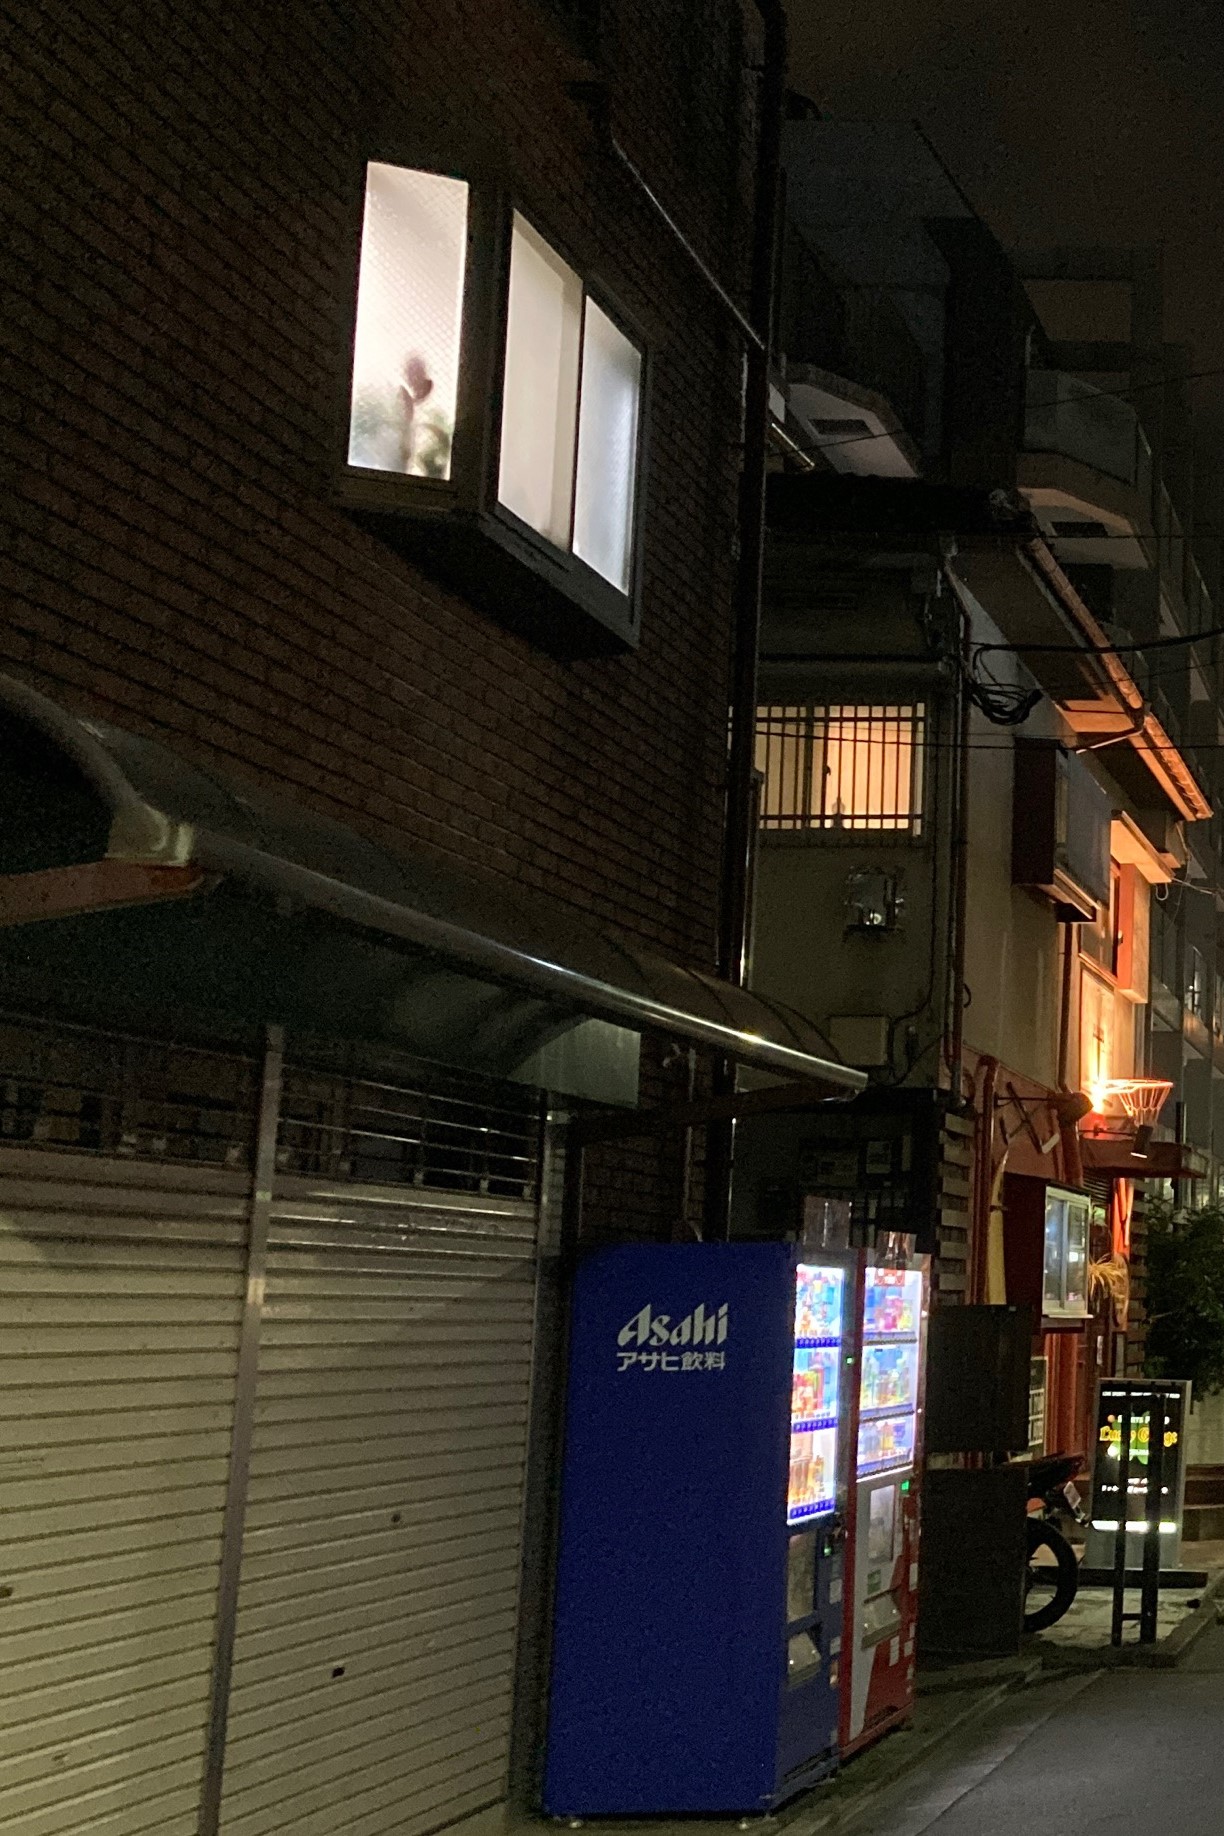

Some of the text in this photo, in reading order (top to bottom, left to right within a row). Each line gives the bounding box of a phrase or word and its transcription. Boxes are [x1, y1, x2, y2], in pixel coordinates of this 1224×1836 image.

[617, 1303, 729, 1347] Asahi
[616, 1351, 725, 1372] アサヒ飲料
